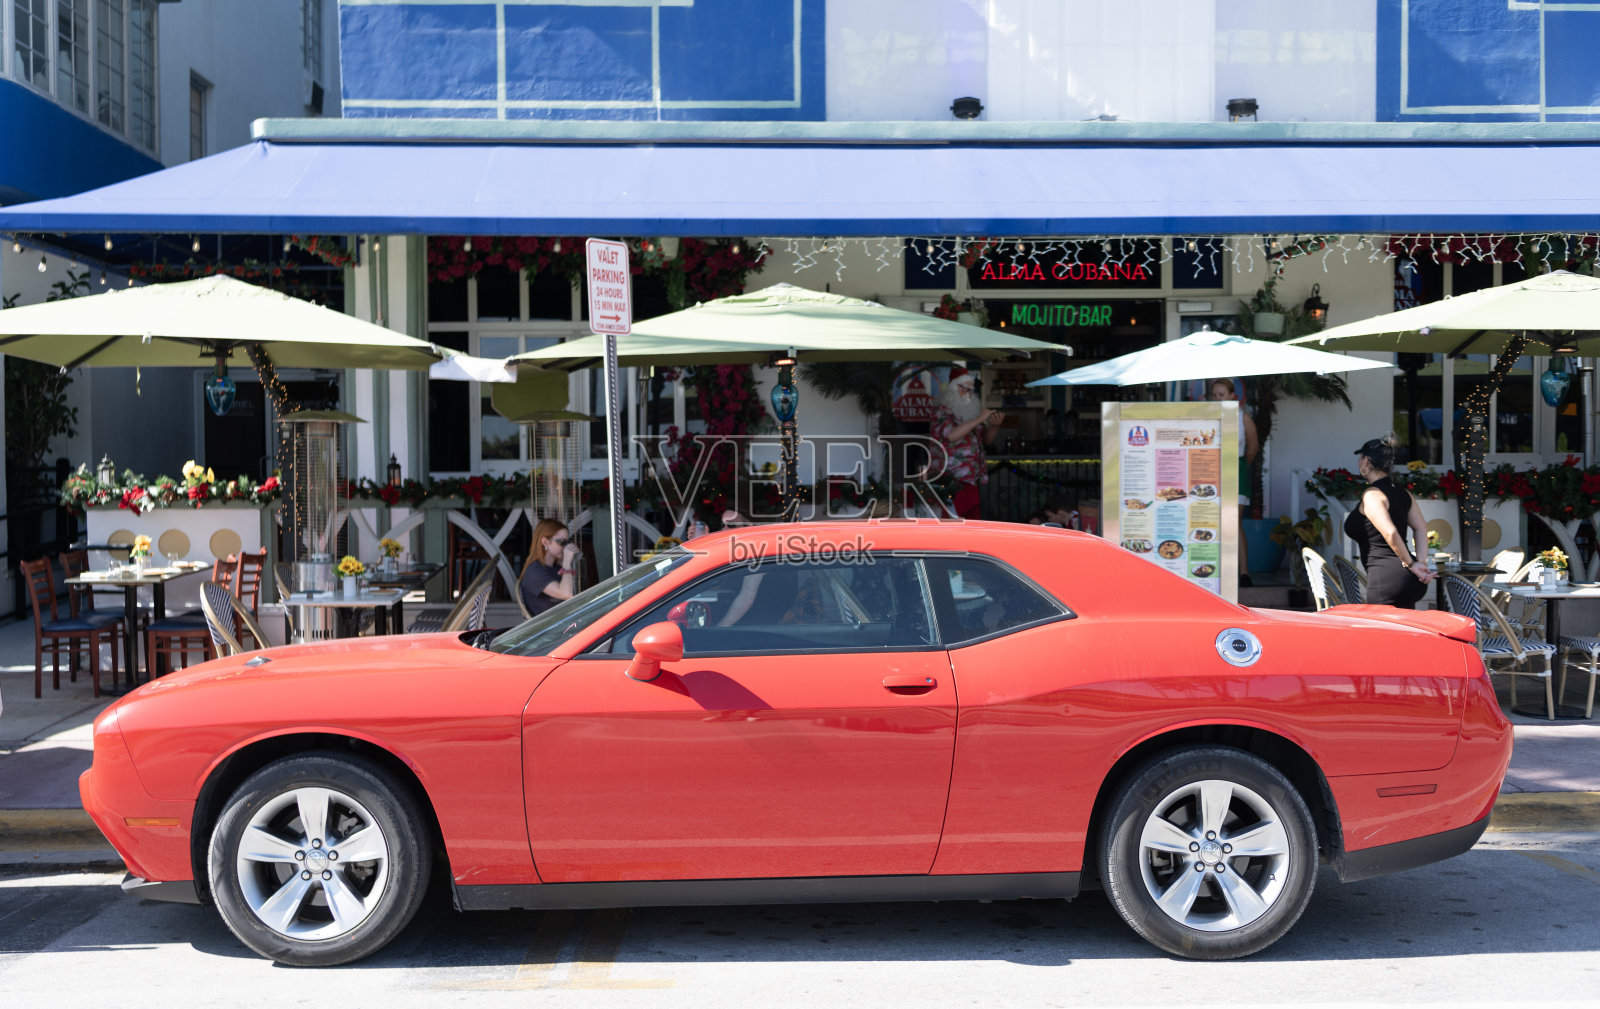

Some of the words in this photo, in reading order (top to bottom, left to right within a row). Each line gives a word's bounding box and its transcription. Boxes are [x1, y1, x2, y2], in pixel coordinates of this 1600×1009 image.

[597, 249, 619, 265] VALET
[592, 268, 625, 285] PARKING
[980, 262, 1046, 280] ALMA
[1051, 262, 1148, 280] CUBANA
[596, 287, 603, 297] 24
[604, 288, 623, 299] HOURS
[594, 300, 601, 311] 15
[601, 301, 613, 312] MIN
[614, 302, 626, 313] MAX
[1012, 304, 1076, 326] MOJITO
[1078, 304, 1113, 326] BAR
[900, 397, 935, 407] ALMA
[891, 407, 934, 417] CUBAN
